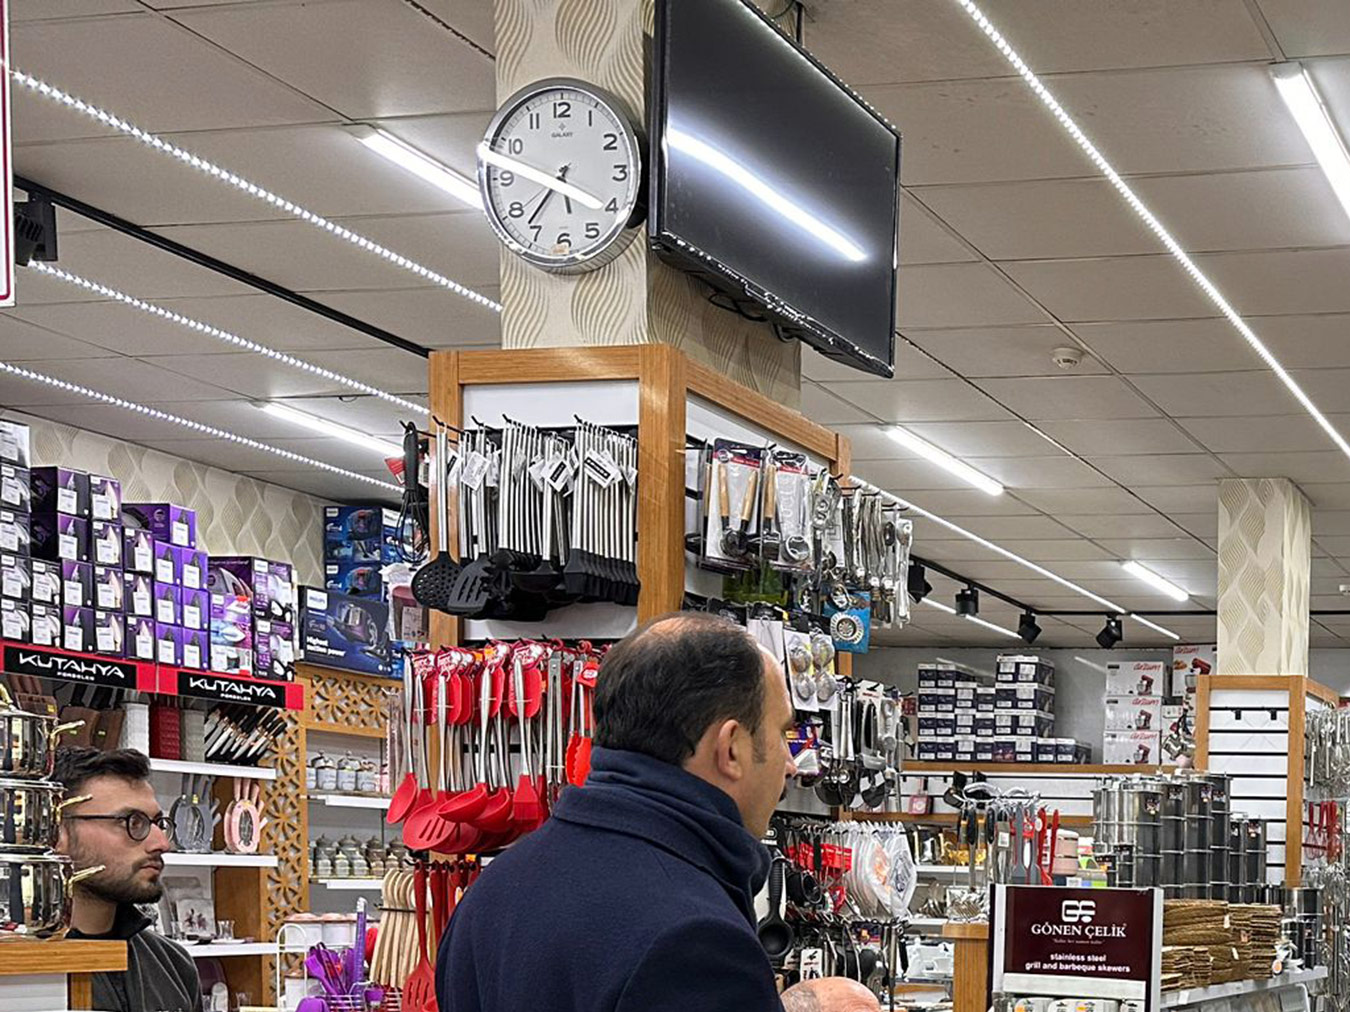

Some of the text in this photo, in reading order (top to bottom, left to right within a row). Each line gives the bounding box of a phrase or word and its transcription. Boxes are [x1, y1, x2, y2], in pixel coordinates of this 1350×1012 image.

[553, 102, 571, 118] 12
[587, 110, 593, 127] 1
[529, 113, 540, 129] 11
[508, 138, 523, 155] 10
[603, 133, 618, 150] 2
[499, 170, 514, 187] 9
[612, 164, 627, 181] 3
[508, 201, 524, 218] 8
[605, 197, 618, 214] 4
[529, 225, 542, 242] 7
[584, 222, 600, 239] 5
[1031, 922, 1126, 939] GÖNEN ÇELİK
[1050, 953, 1107, 962] stainless steel
[1025, 961, 1131, 973] grill and barbeque skewers
